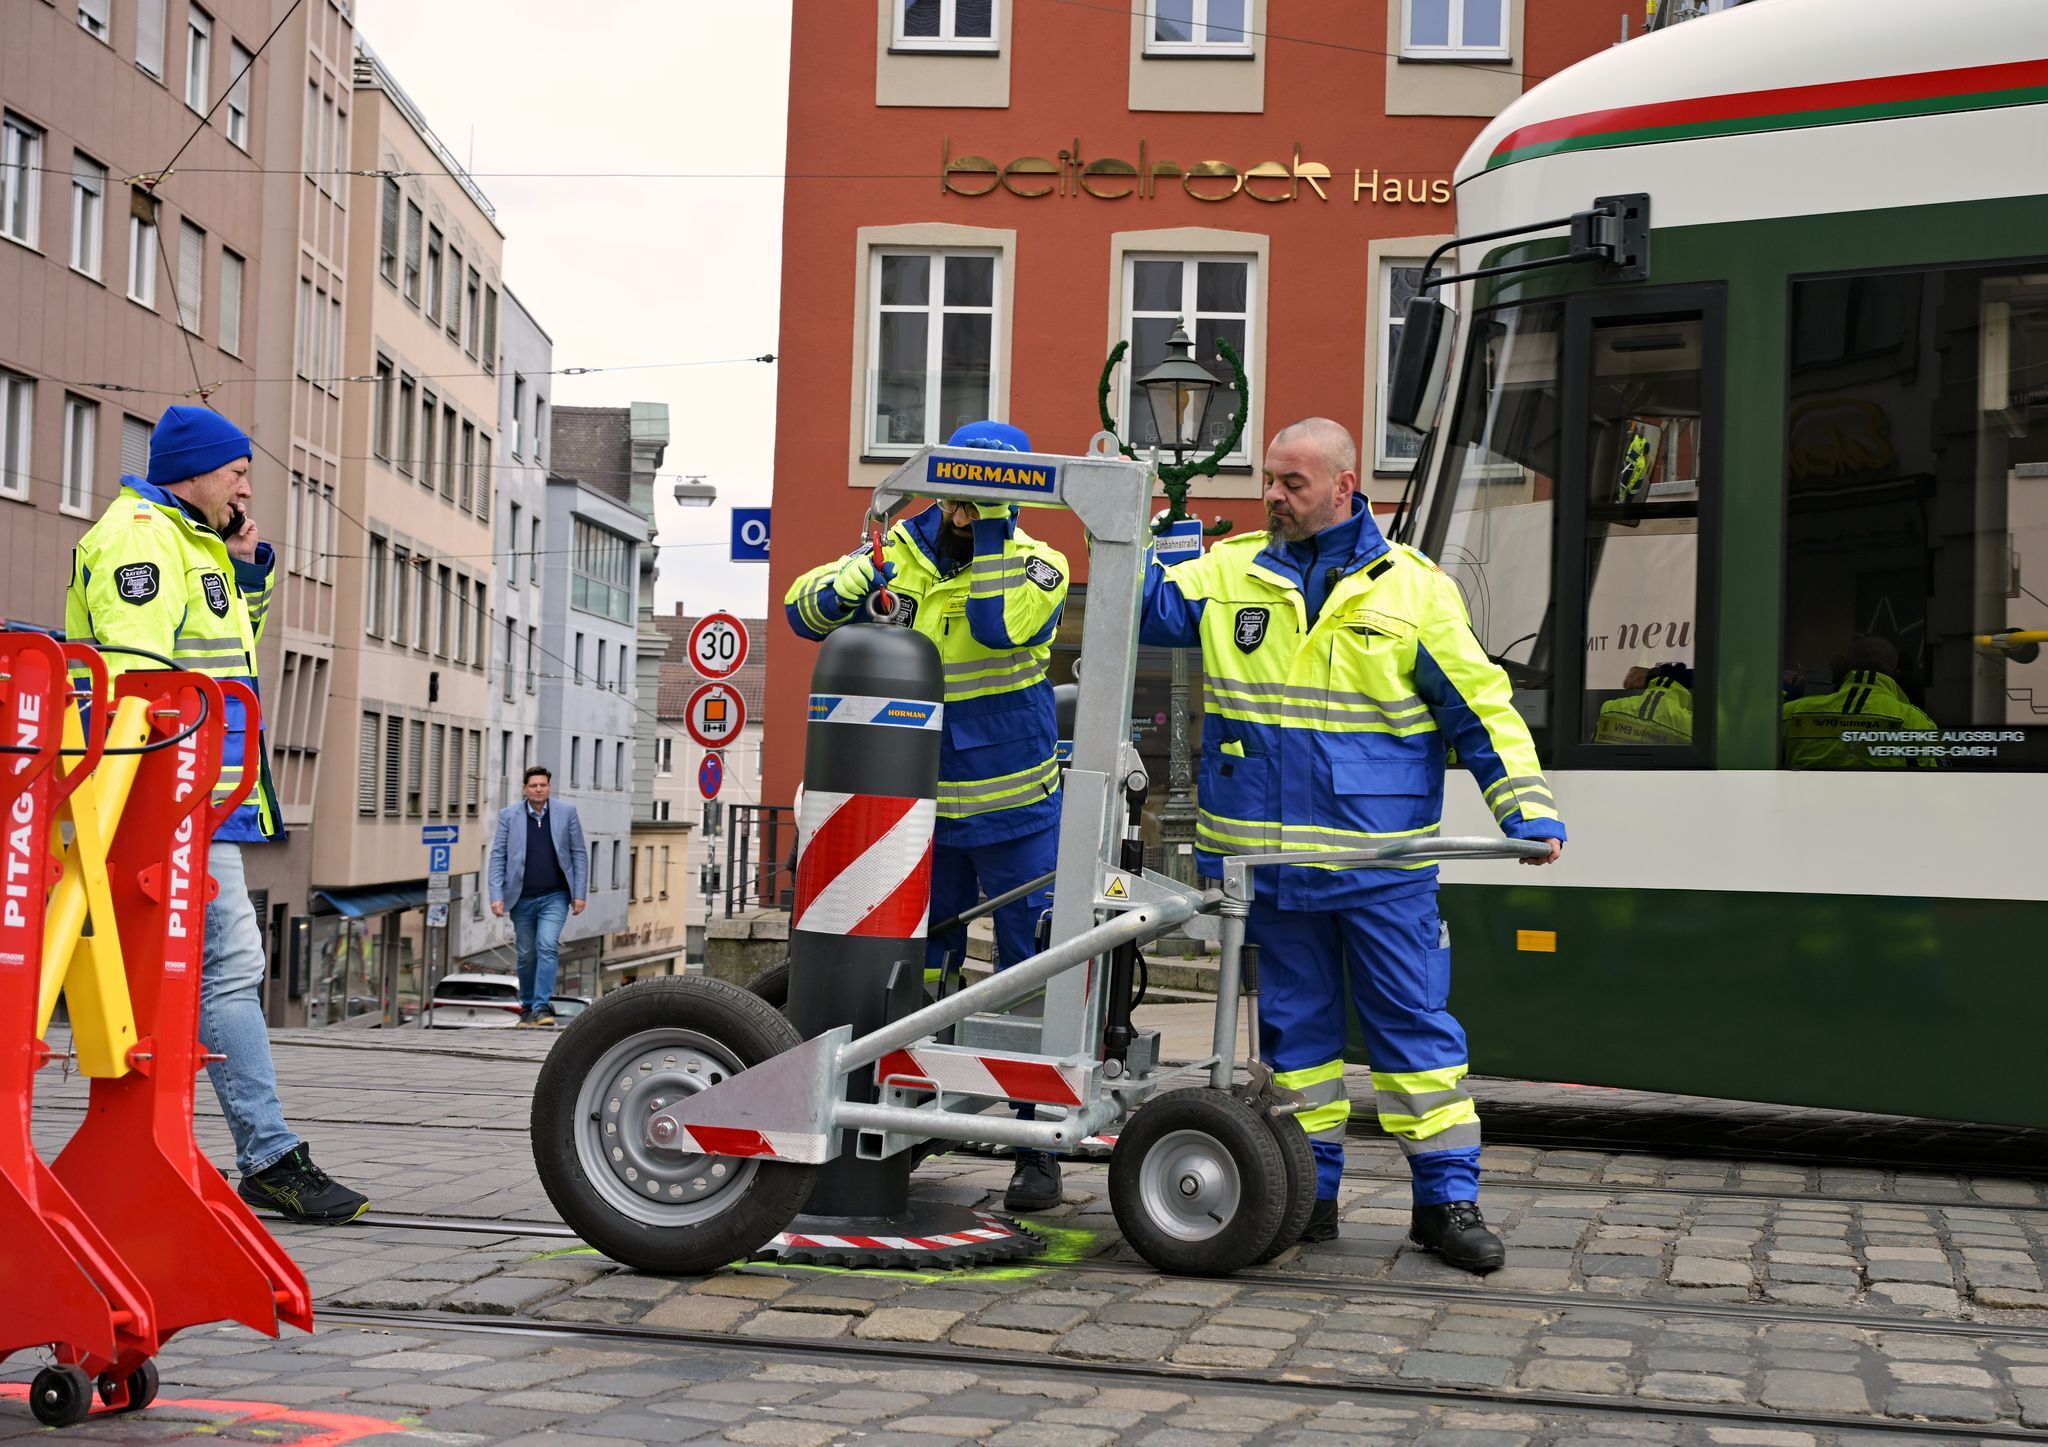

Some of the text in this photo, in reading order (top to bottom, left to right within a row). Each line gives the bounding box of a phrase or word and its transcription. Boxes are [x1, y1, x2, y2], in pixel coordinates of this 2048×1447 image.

[1353, 168, 1451, 203] Haus
[936, 462, 1047, 487] HÖRMANN
[1155, 538, 1198, 550] Einbahnstraße
[701, 631, 735, 661] 30
[1617, 621, 1696, 650] neu
[1841, 731, 2025, 742] STADTWERKE AUGSBURG
[1867, 746, 1997, 757] VERKEHRS-GMBH
[434, 848, 447, 870] P
